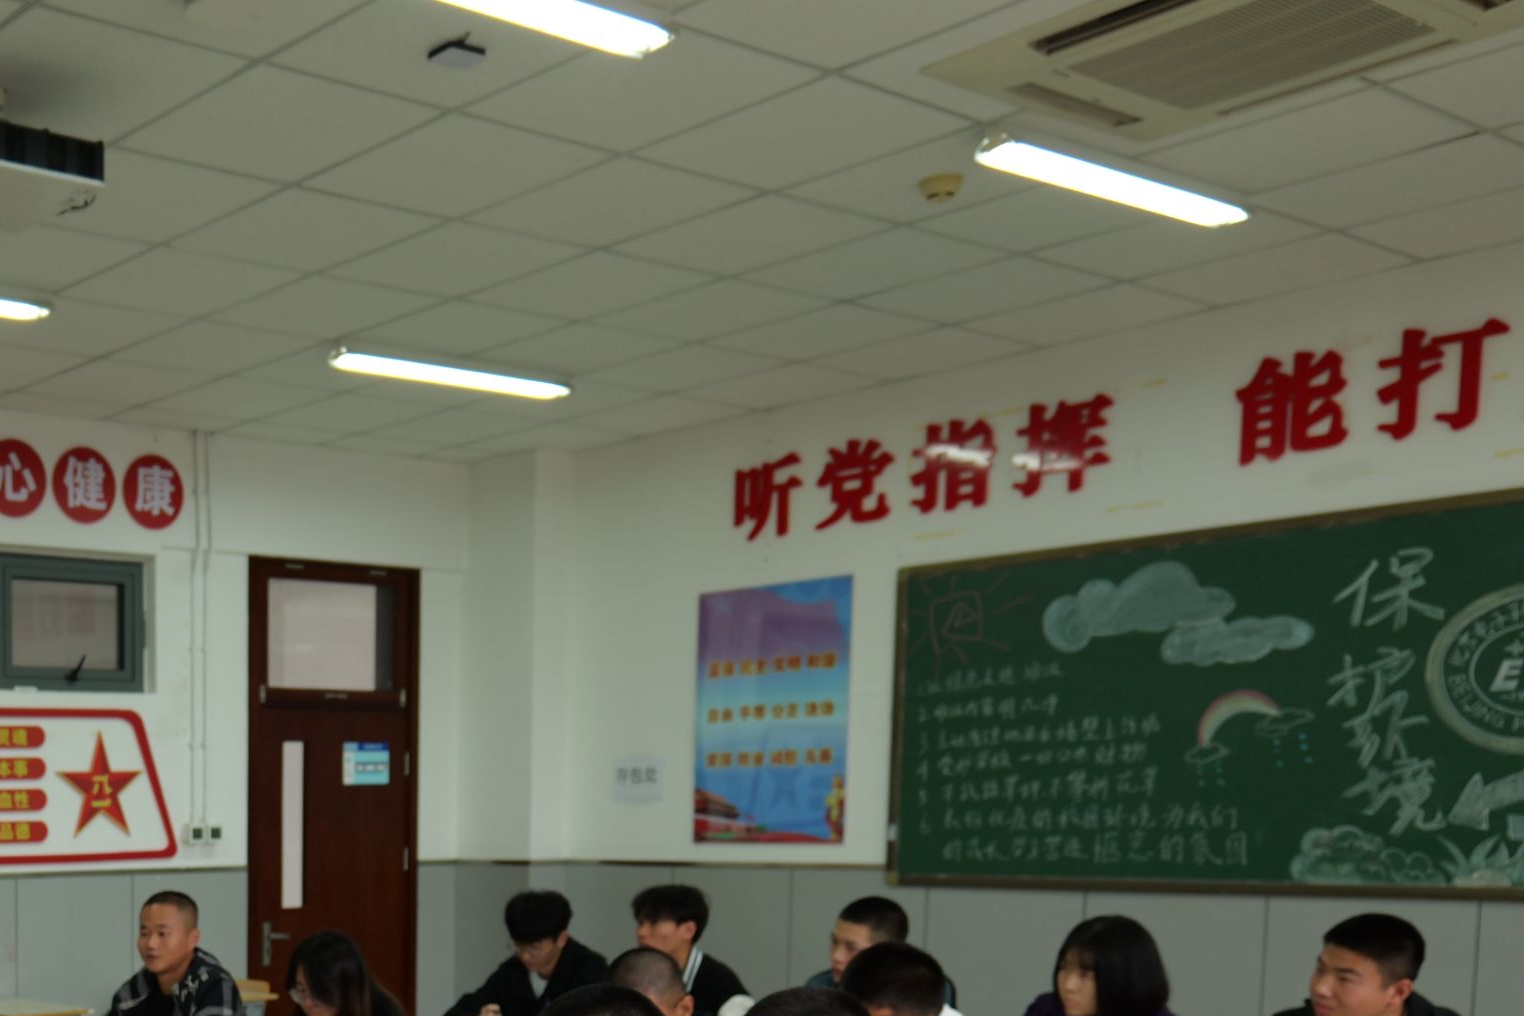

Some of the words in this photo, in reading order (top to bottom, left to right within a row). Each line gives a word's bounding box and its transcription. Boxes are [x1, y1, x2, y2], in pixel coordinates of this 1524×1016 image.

[732, 393, 1115, 542] 听党指挥
[1235, 316, 1512, 467] 能打
